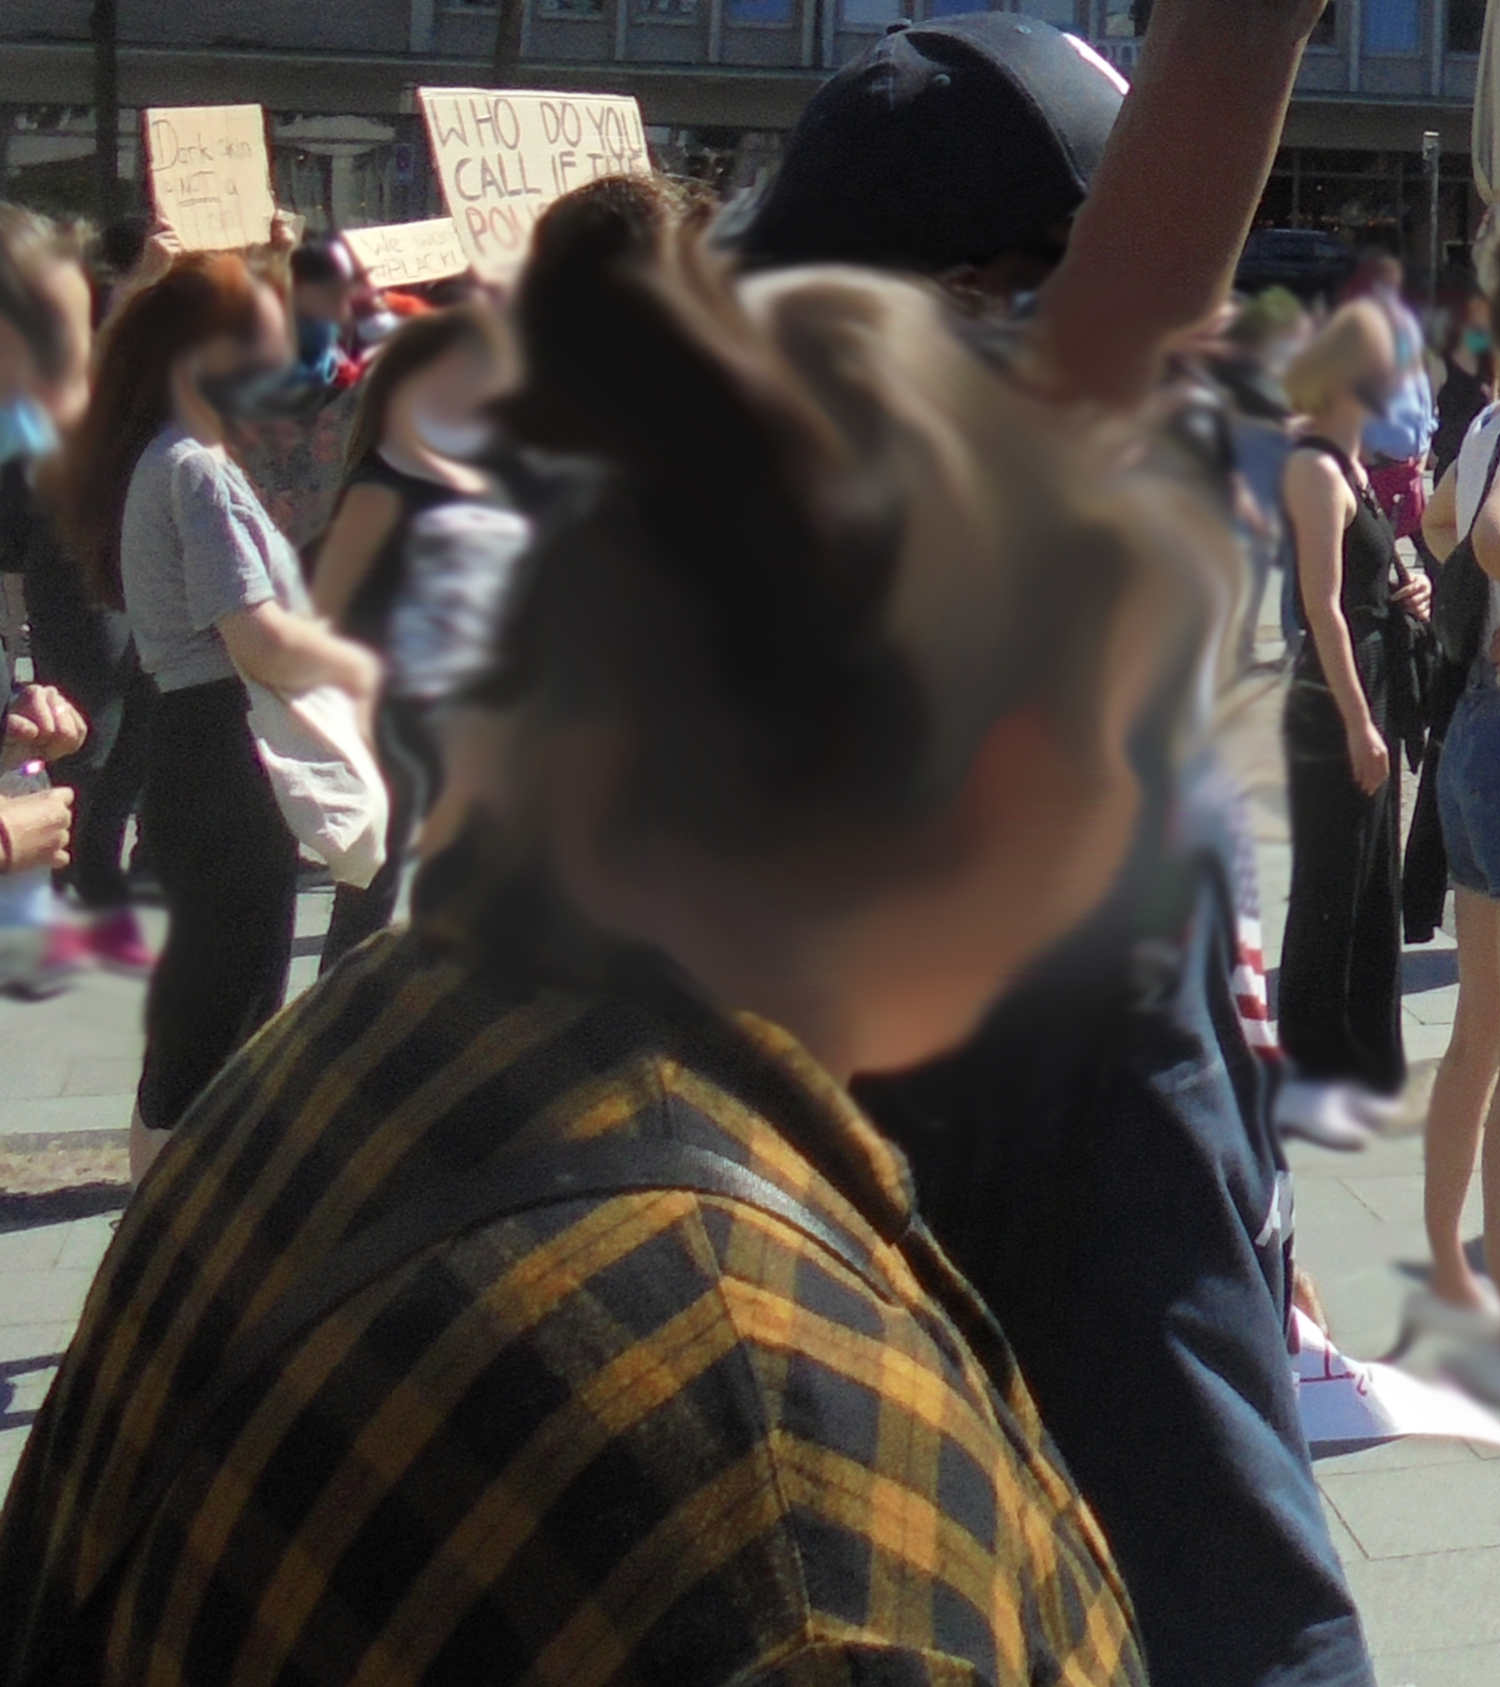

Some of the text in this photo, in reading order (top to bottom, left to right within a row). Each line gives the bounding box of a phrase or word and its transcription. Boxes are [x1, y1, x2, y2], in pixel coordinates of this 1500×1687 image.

[430, 97, 642, 155] WHO DO YOU
[454, 150, 542, 201] CALL
[551, 150, 577, 196] IF
